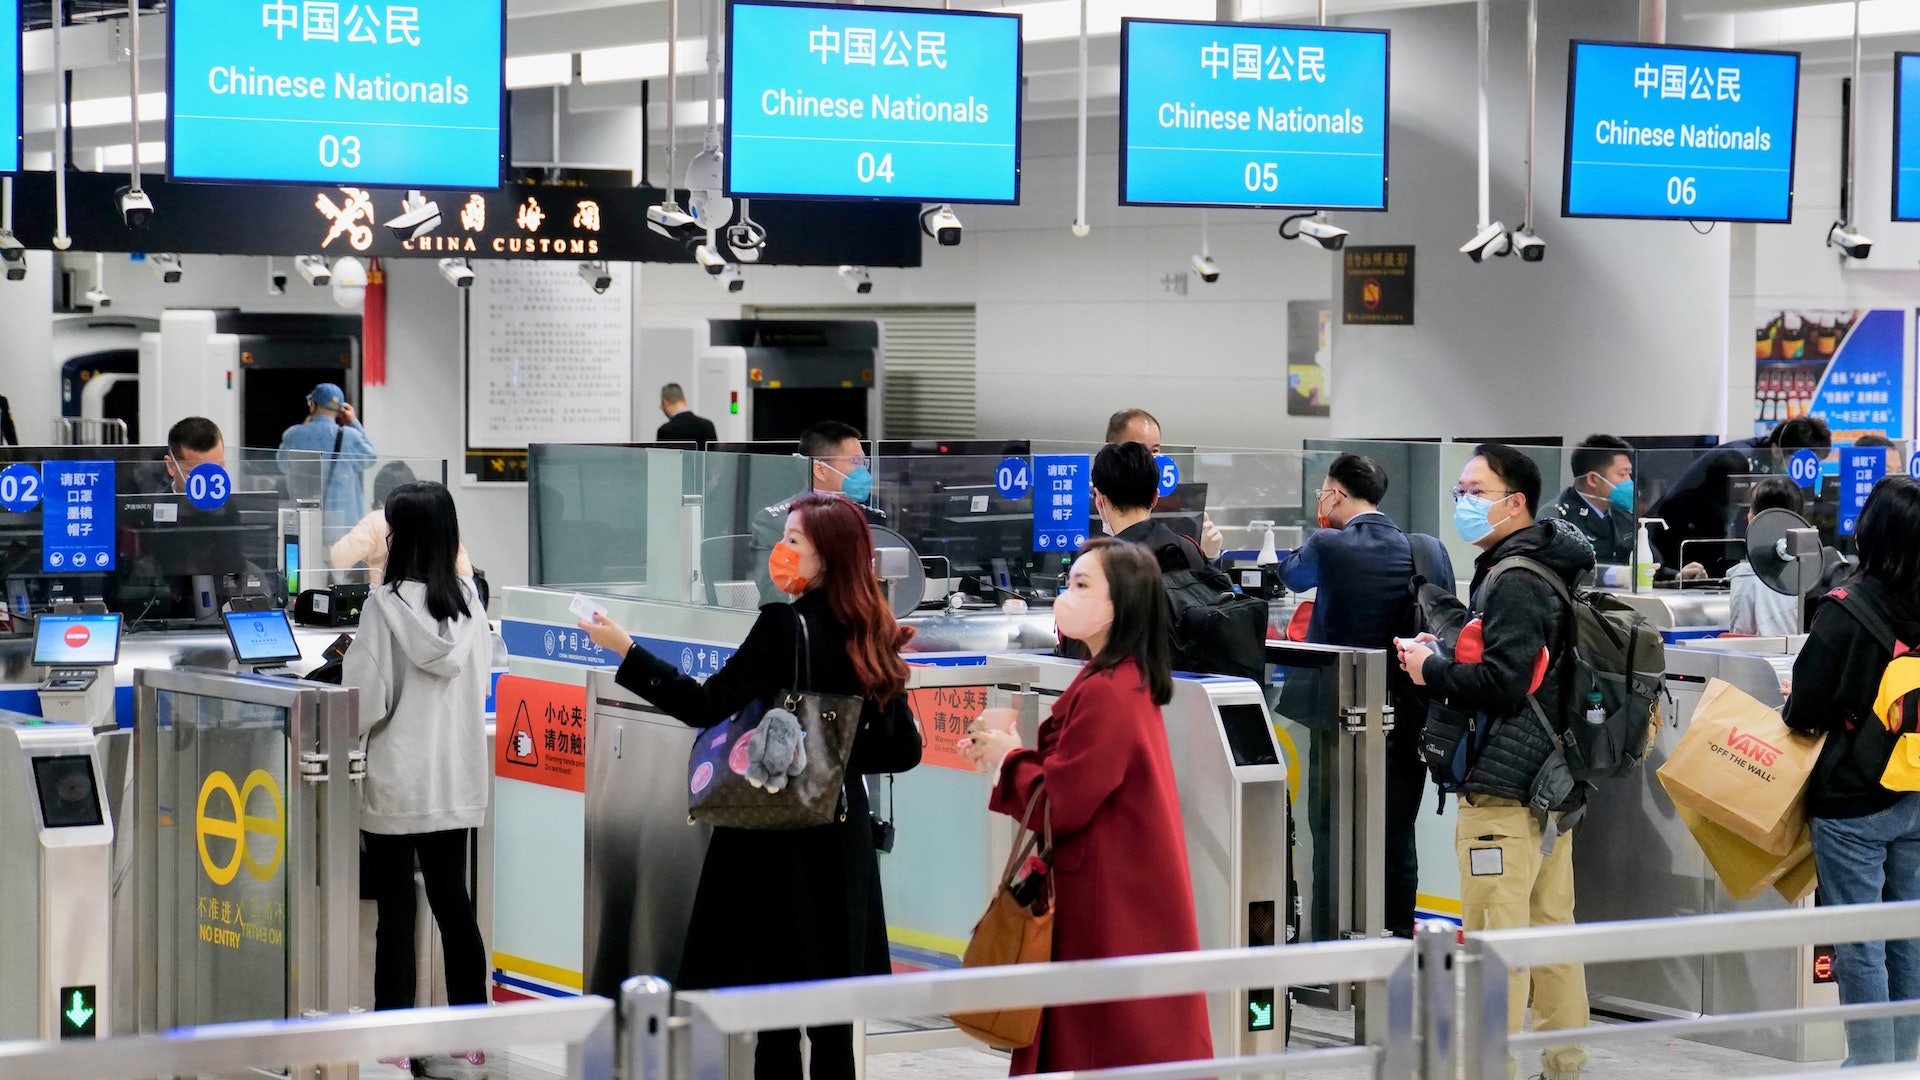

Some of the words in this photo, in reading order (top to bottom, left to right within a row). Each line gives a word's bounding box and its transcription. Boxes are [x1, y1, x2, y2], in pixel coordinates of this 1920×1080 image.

[262, 0, 421, 47] 中国公民
[808, 25, 948, 70] 中国公民
[1200, 41, 1326, 83] 中国公民
[208, 66, 326, 99] Chinese
[334, 72, 469, 105] Nationals
[1634, 62, 1741, 103] 中国公民
[761, 88, 864, 119] Chinese
[871, 94, 989, 124] Nationals
[1158, 102, 1251, 131] Chinese
[1257, 106, 1364, 135] Nationals
[1595, 119, 1675, 148] Chinese
[1680, 125, 1771, 151] Nationals
[318, 134, 361, 169] 03
[856, 152, 895, 184] 04
[1244, 162, 1279, 192] 05
[1667, 176, 1697, 205] 06
[402, 235, 477, 252] CHINA
[492, 237, 600, 254] CUSTOMS
[60, 473, 99, 486] 请取下
[998, 467, 1028, 491] 04
[1047, 465, 1078, 477] 请取下
[1162, 465, 1176, 488] 5
[1791, 458, 1817, 480] 06
[0, 474, 39, 503] 02
[67, 490, 92, 503] 口罩
[190, 473, 227, 501] 03
[1053, 480, 1073, 491] 口罩
[67, 507, 93, 520] 墨镜
[1052, 495, 1073, 506] 墨镜
[1052, 509, 1073, 521] 帽子
[67, 523, 93, 537] 帽子
[934, 687, 987, 712] 小心夹手
[544, 701, 586, 729] 小心夹
[544, 728, 586, 756] 请勿触
[1727, 726, 1783, 768] VANS
[1729, 752, 1748, 768] THE
[197, 895, 244, 929] 不准进入
[199, 923, 213, 943] NO
[213, 927, 241, 950] ENTRY
